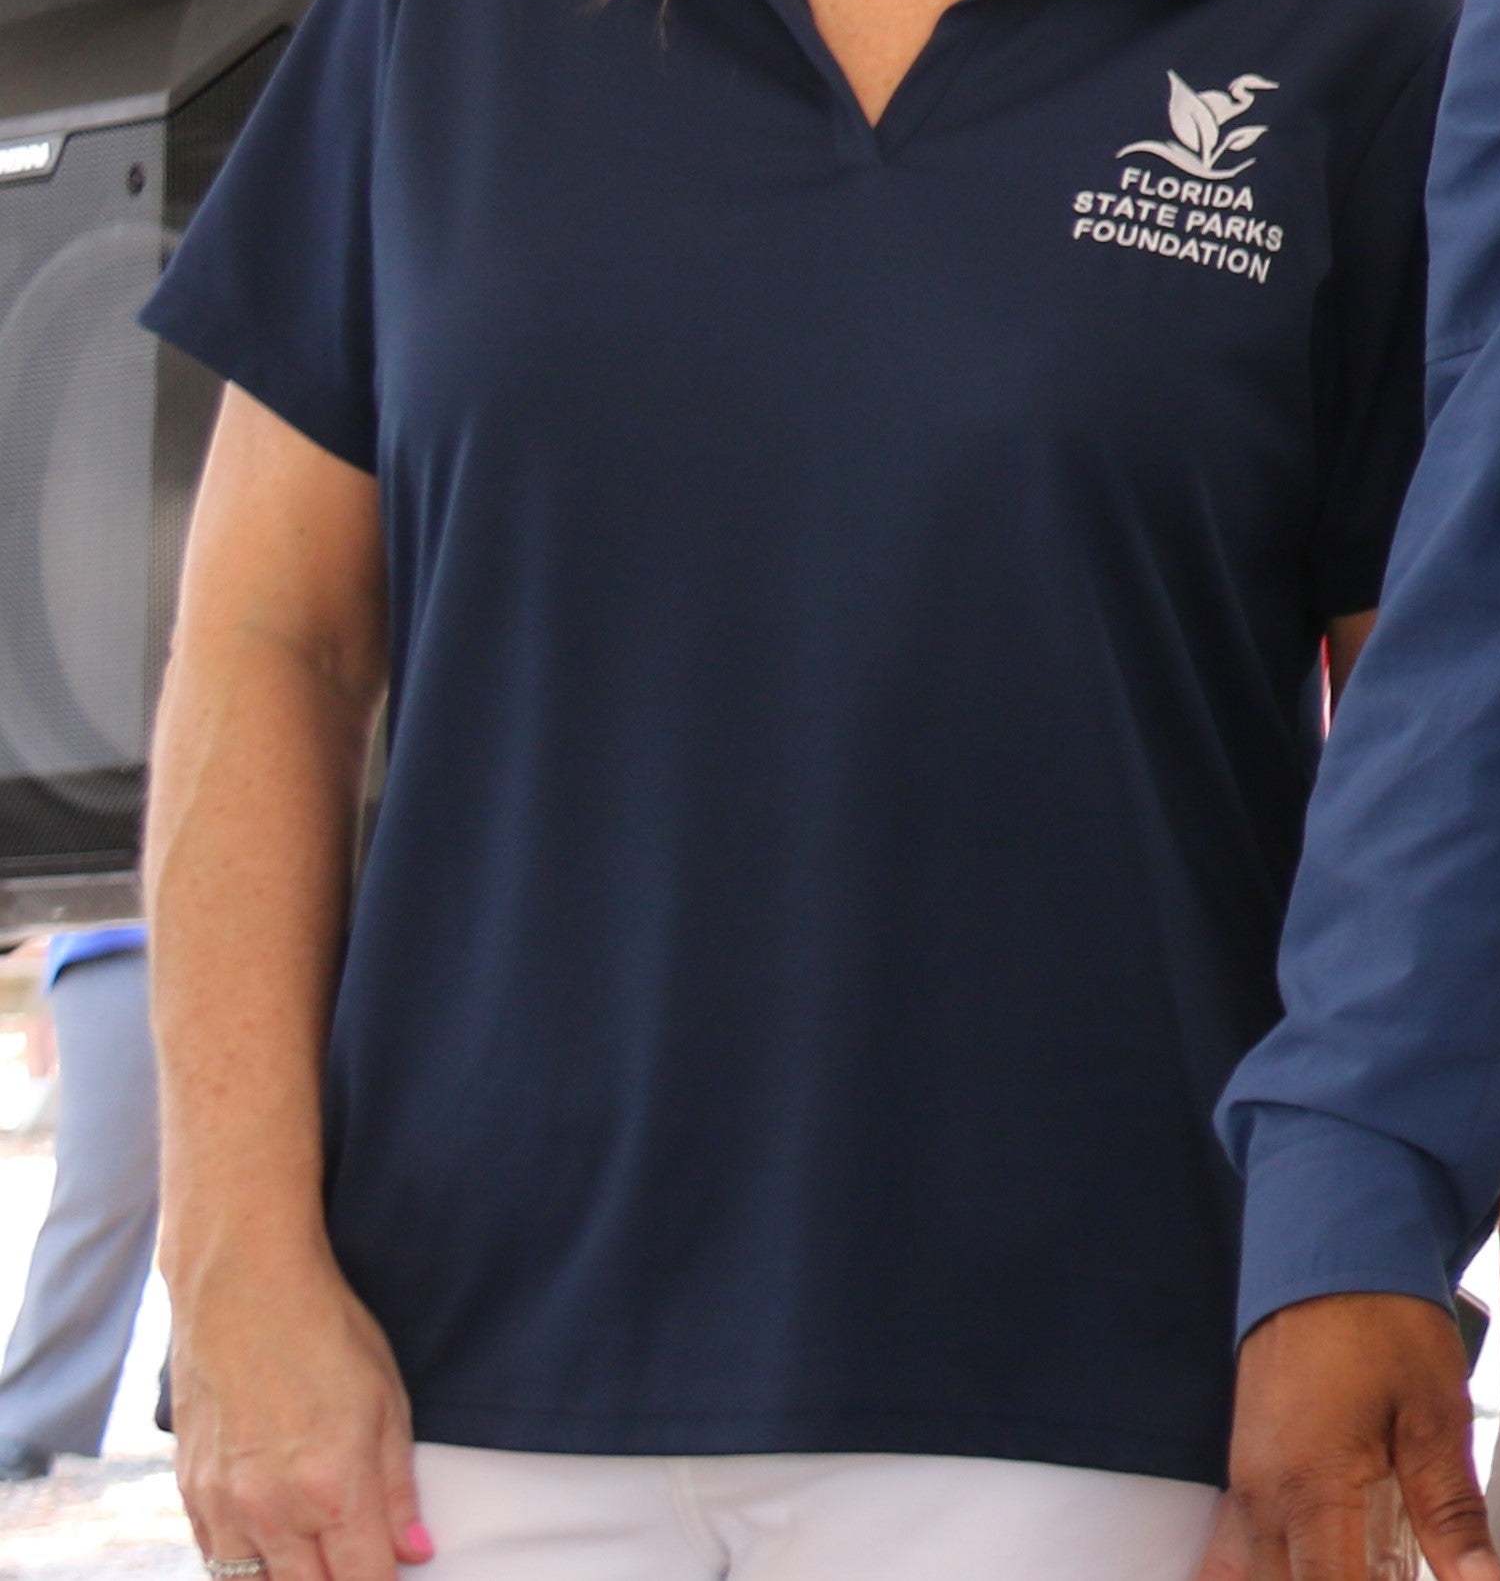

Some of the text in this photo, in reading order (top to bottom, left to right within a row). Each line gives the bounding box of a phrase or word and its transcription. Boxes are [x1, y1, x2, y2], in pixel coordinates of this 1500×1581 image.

[1120, 166, 1255, 212] FLORIDA
[1073, 190, 1284, 253] STATE PARKS
[1073, 218, 1271, 285] FOUNDATION
